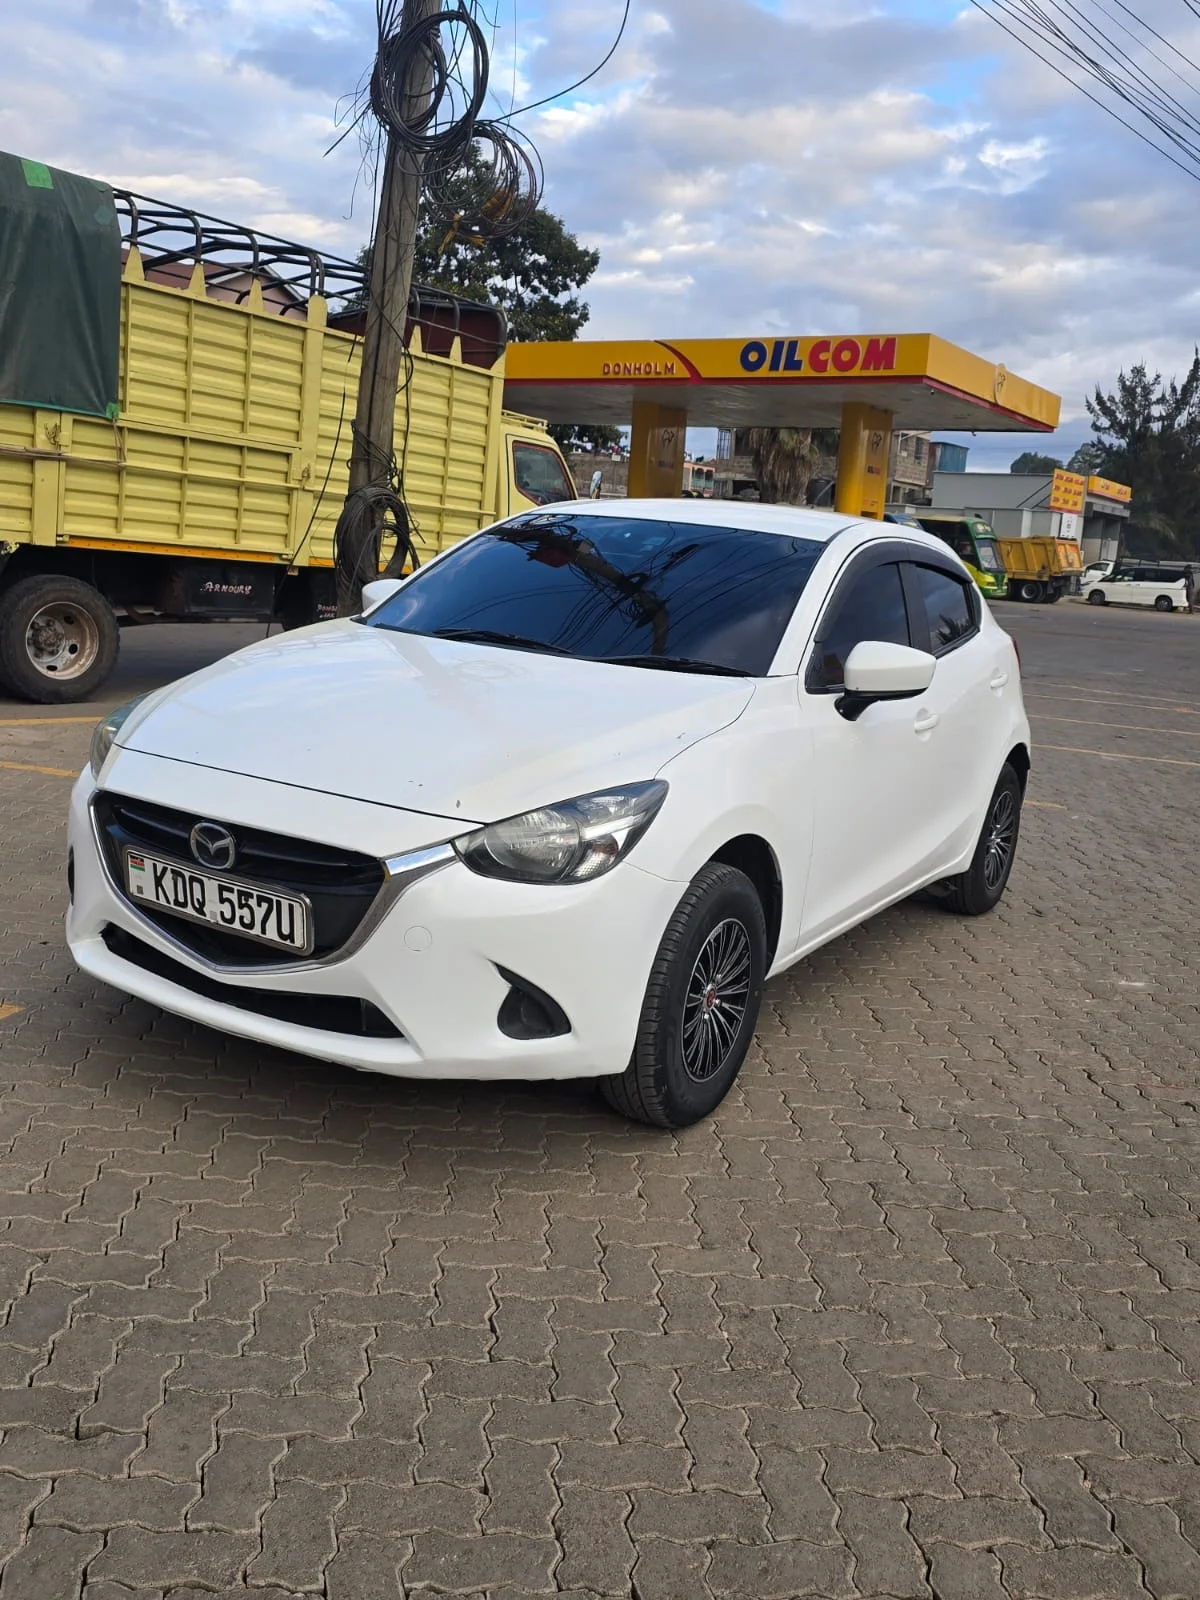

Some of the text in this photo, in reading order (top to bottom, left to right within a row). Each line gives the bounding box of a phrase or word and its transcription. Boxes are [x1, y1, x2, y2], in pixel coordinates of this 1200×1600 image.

[602, 362, 676, 377] DONHOLM
[740, 337, 897, 372] OILCOM
[152, 862, 296, 945] KDQ 557U
